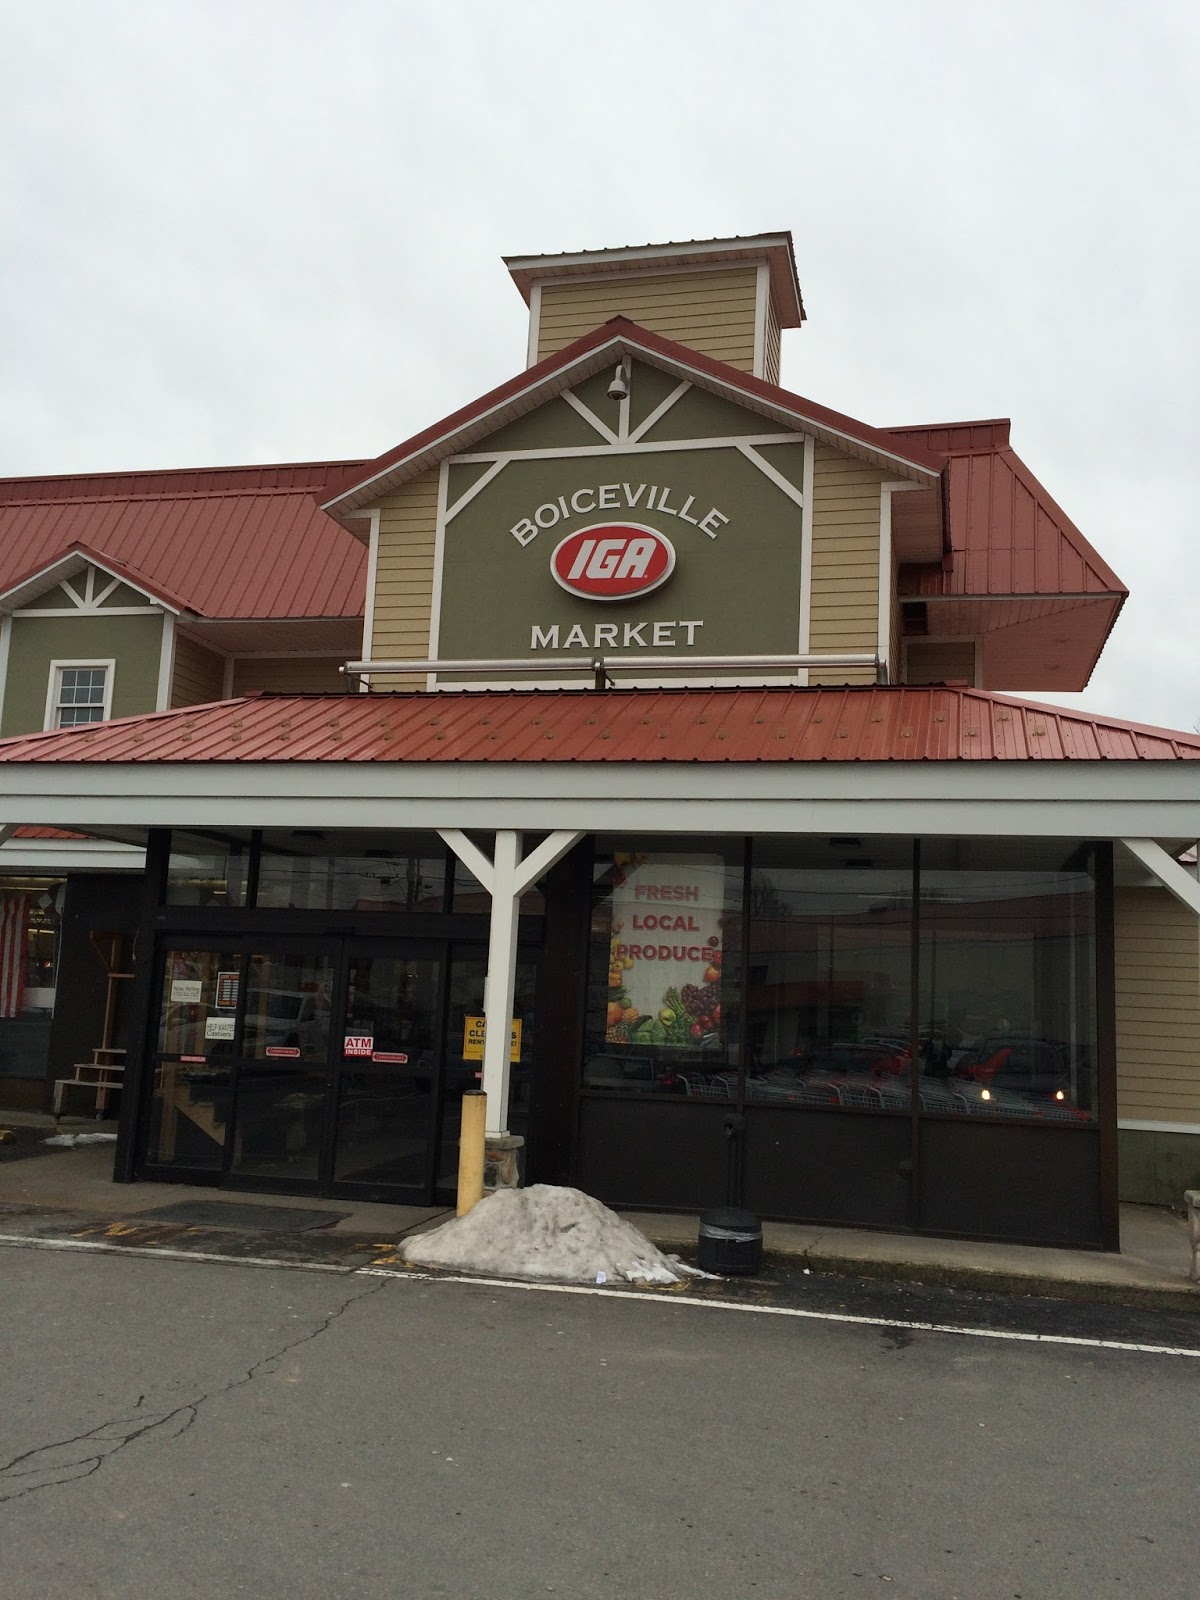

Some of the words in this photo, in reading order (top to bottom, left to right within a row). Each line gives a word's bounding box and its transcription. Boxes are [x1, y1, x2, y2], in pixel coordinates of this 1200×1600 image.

[510, 483, 730, 547] BOICEVILLE
[567, 538, 657, 579] IGA
[530, 620, 704, 649] MARKET
[634, 885, 700, 901] FRESH
[632, 914, 700, 931] LOCAL
[615, 944, 714, 963] PRODUCE
[345, 1038, 372, 1048] ATM
